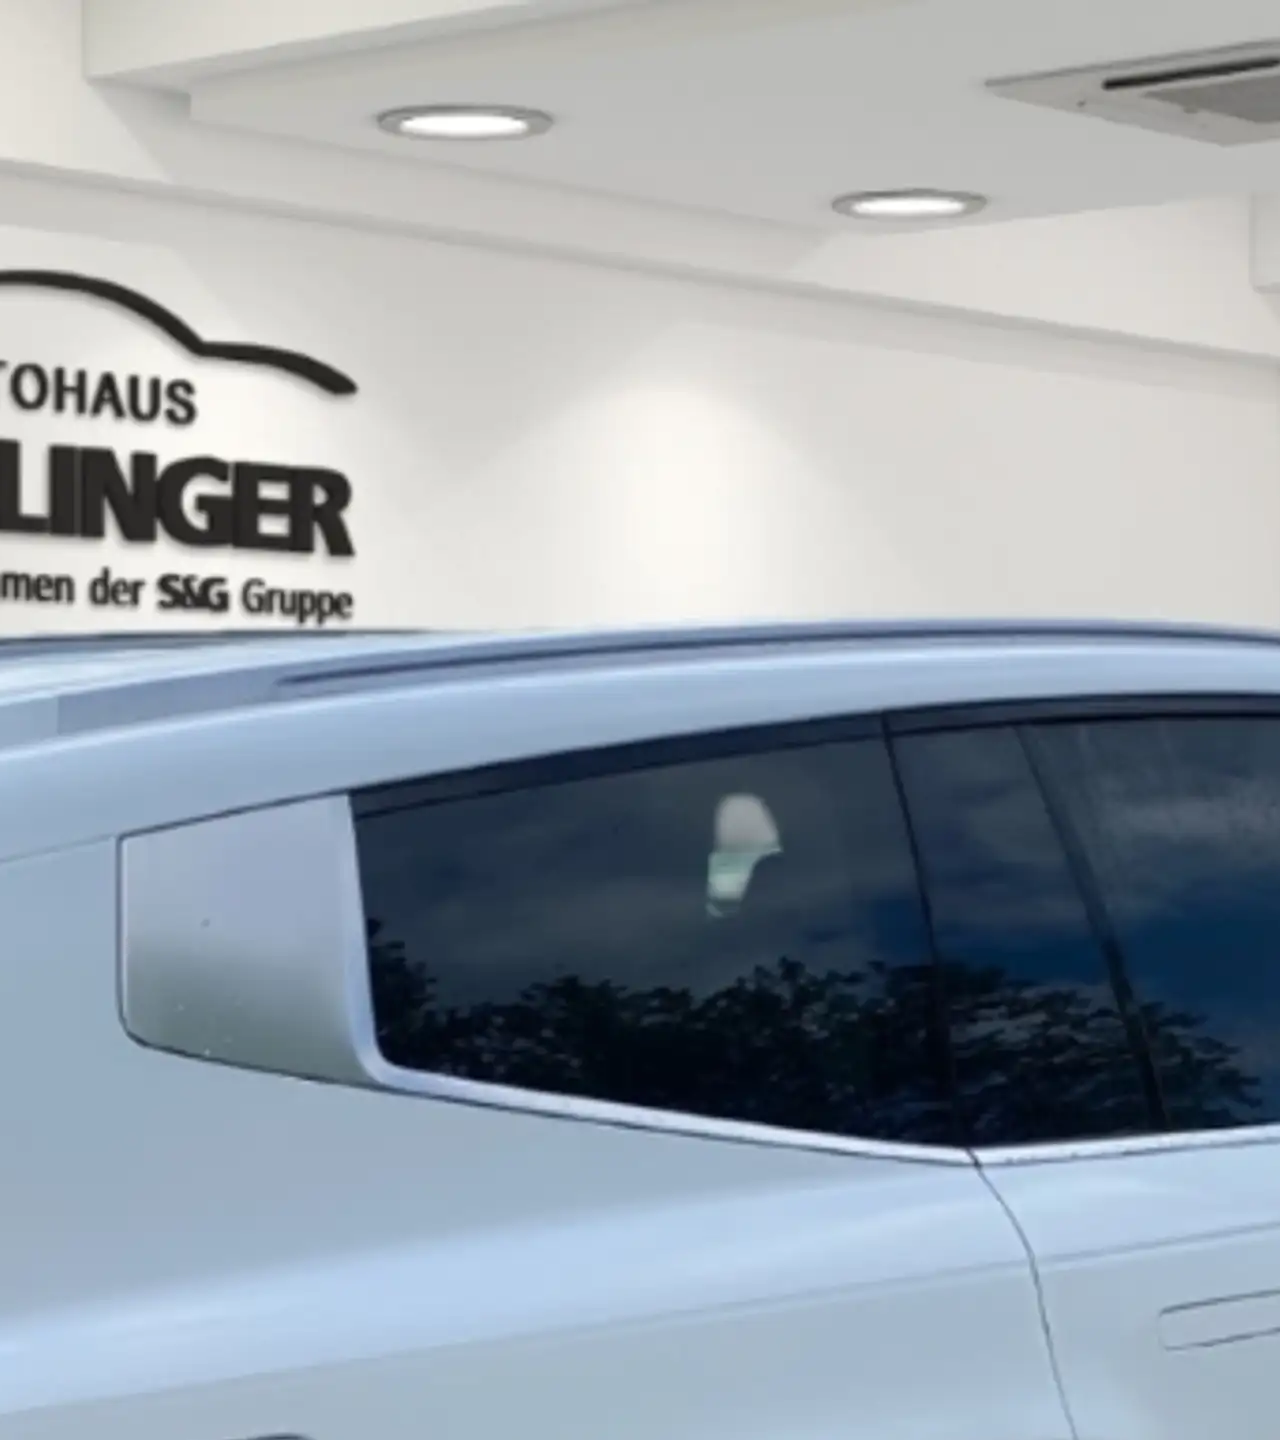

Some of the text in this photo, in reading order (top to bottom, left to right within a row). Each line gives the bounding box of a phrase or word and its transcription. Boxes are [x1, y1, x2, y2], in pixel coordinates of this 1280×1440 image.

[88, 566, 146, 609] der
[156, 572, 230, 614] S&G
[240, 577, 354, 626] Gruppe
